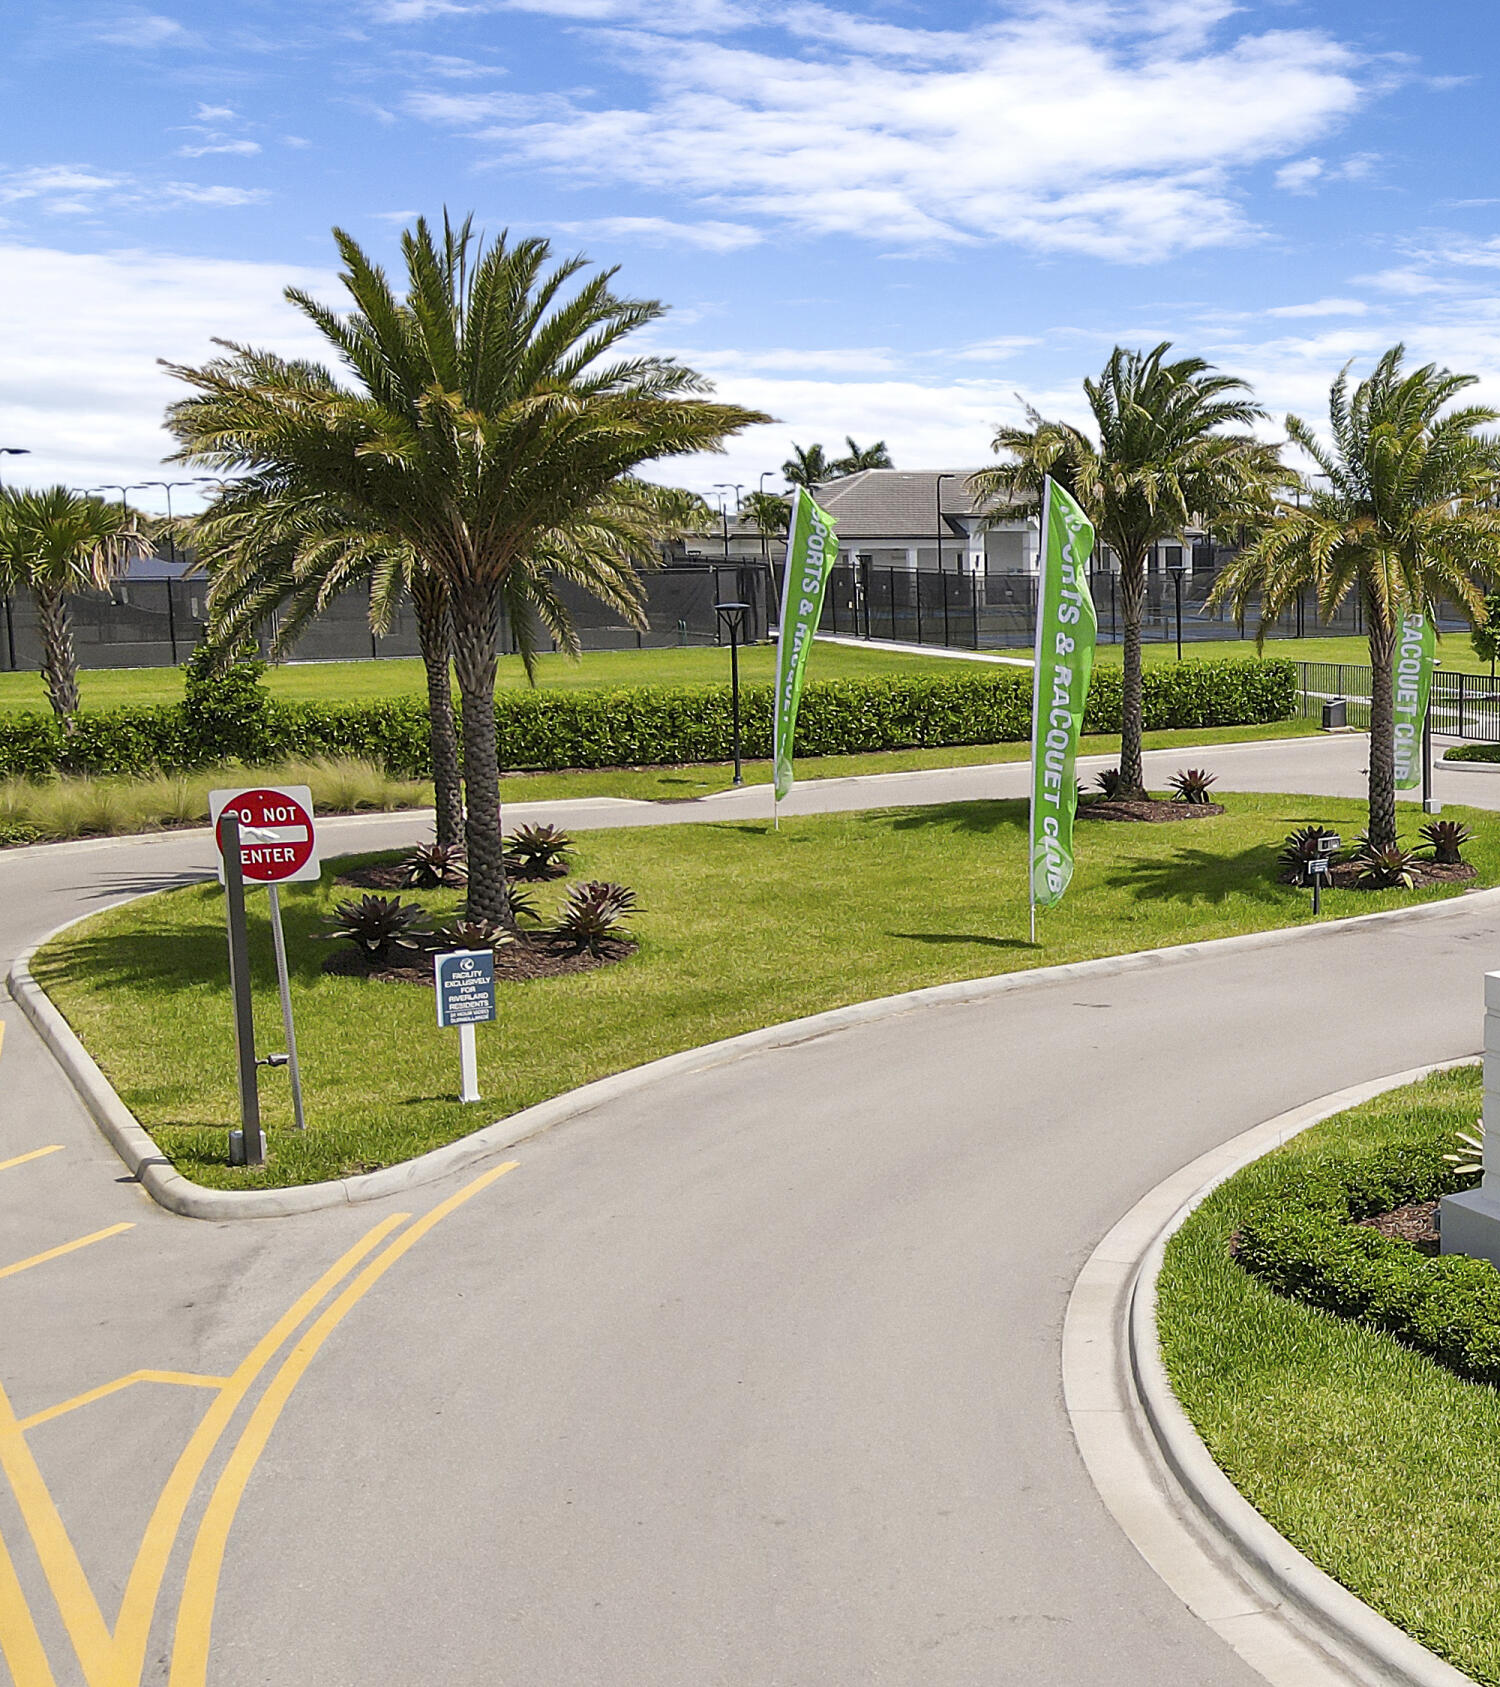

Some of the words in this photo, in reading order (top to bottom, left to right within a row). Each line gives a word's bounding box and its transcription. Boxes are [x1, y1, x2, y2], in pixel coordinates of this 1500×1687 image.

[1058, 505, 1083, 625] PORTS
[800, 599, 814, 616] &
[1056, 632, 1075, 655] &
[1396, 613, 1423, 717] RACQUET
[1044, 665, 1073, 810] RACQUET
[1394, 722, 1415, 780] CLUB
[228, 809, 252, 823] O
[263, 806, 296, 822] NOT
[241, 847, 296, 864] ENTER
[1042, 816, 1063, 893] CLUB
[444, 976, 491, 988] EXCLUSIVELY
[452, 970, 482, 979] FACILITY
[448, 992, 489, 1002] RIVERLAND
[460, 986, 476, 994] FOR
[449, 1000, 489, 1010] RESIDENTS
